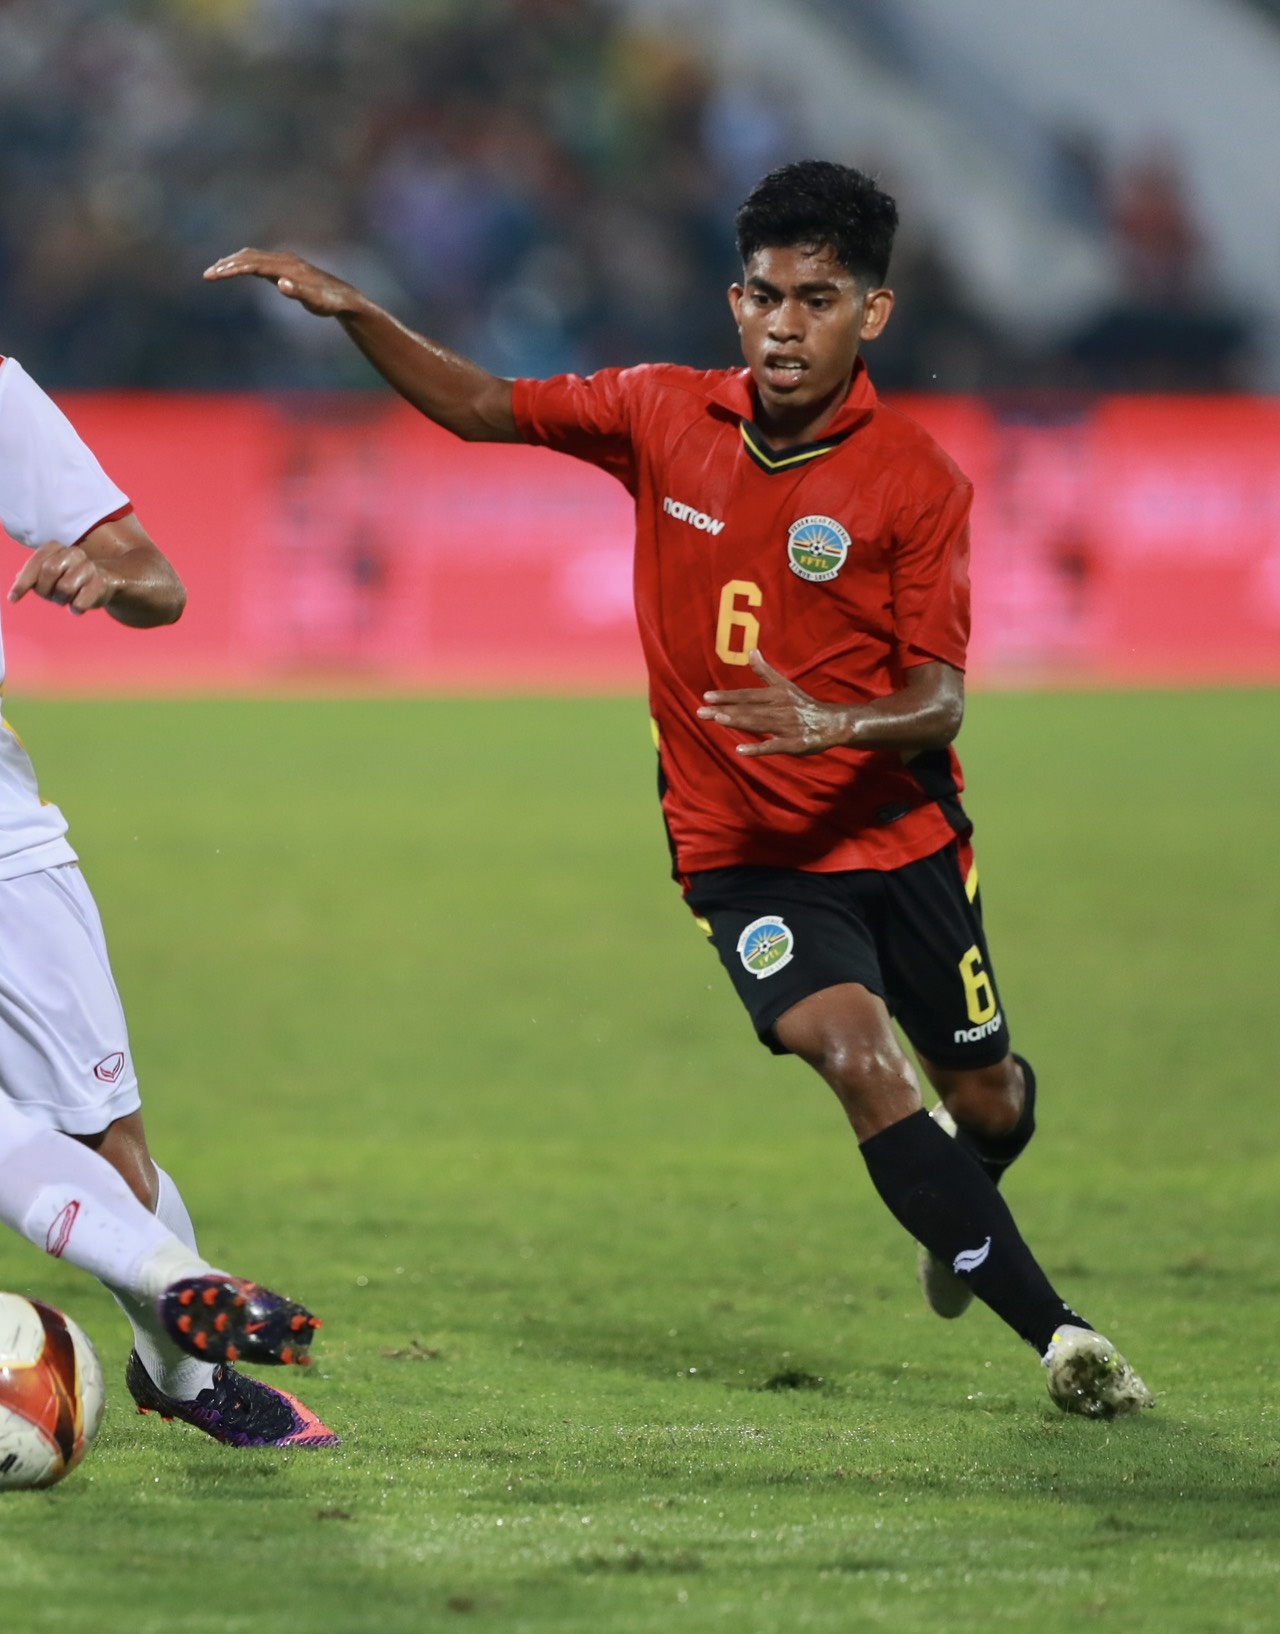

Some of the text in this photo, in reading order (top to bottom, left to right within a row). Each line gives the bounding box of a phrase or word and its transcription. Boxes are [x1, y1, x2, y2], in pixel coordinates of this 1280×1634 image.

[663, 496, 725, 536] narrow
[799, 555, 829, 570] FFTL
[715, 579, 762, 666] 6
[959, 944, 996, 1025] 6
